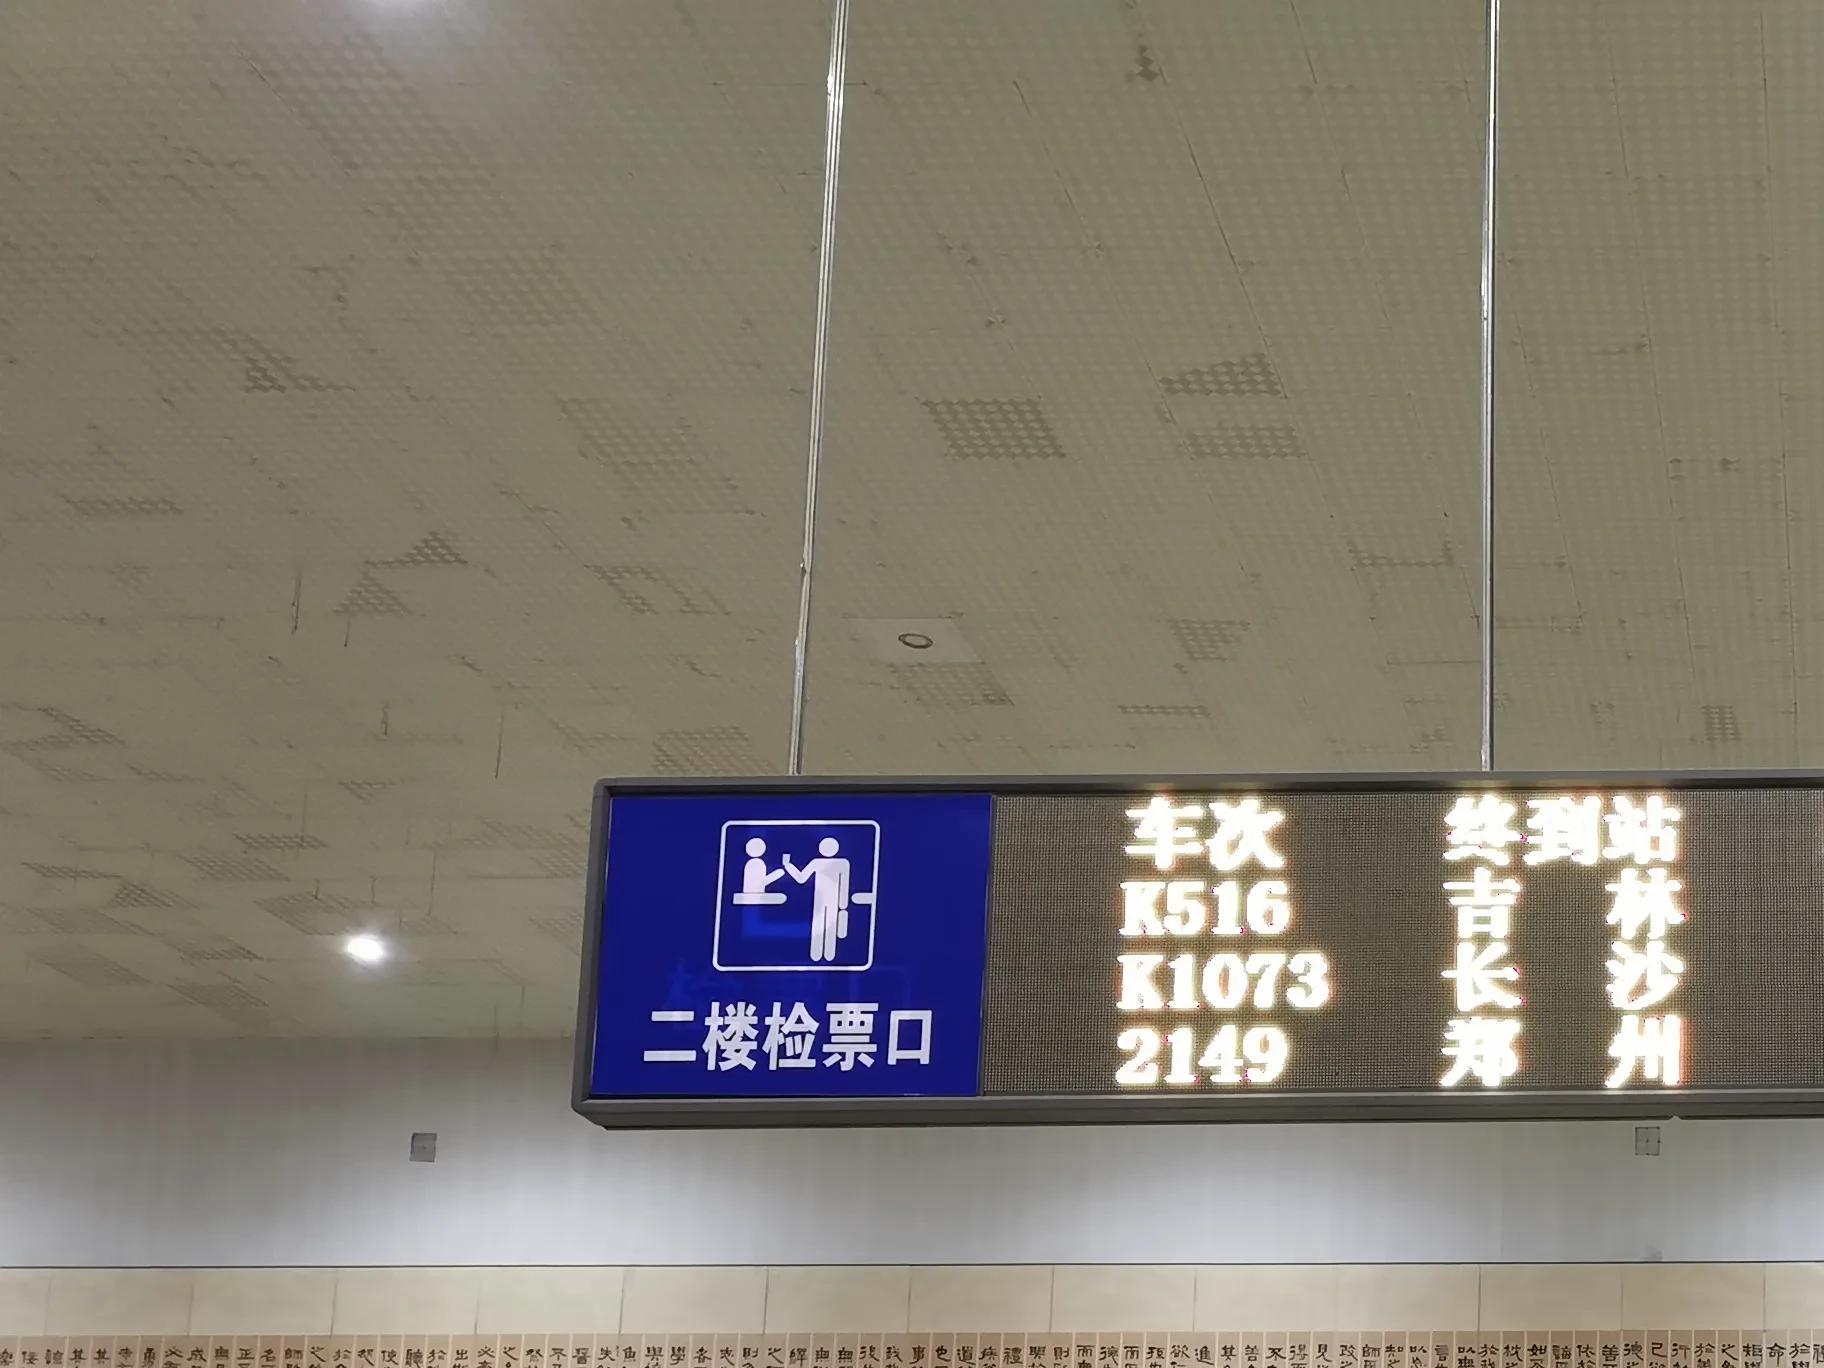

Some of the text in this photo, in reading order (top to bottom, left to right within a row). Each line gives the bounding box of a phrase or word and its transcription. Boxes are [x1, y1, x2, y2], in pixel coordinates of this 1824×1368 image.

[1125, 795, 1285, 871] 车次
[1441, 793, 1682, 868] 终到站
[1119, 880, 1291, 937] K516
[1117, 952, 1330, 1012] K1073
[642, 1001, 933, 1072] 二楼检票口
[1116, 1024, 1290, 1085] 2149
